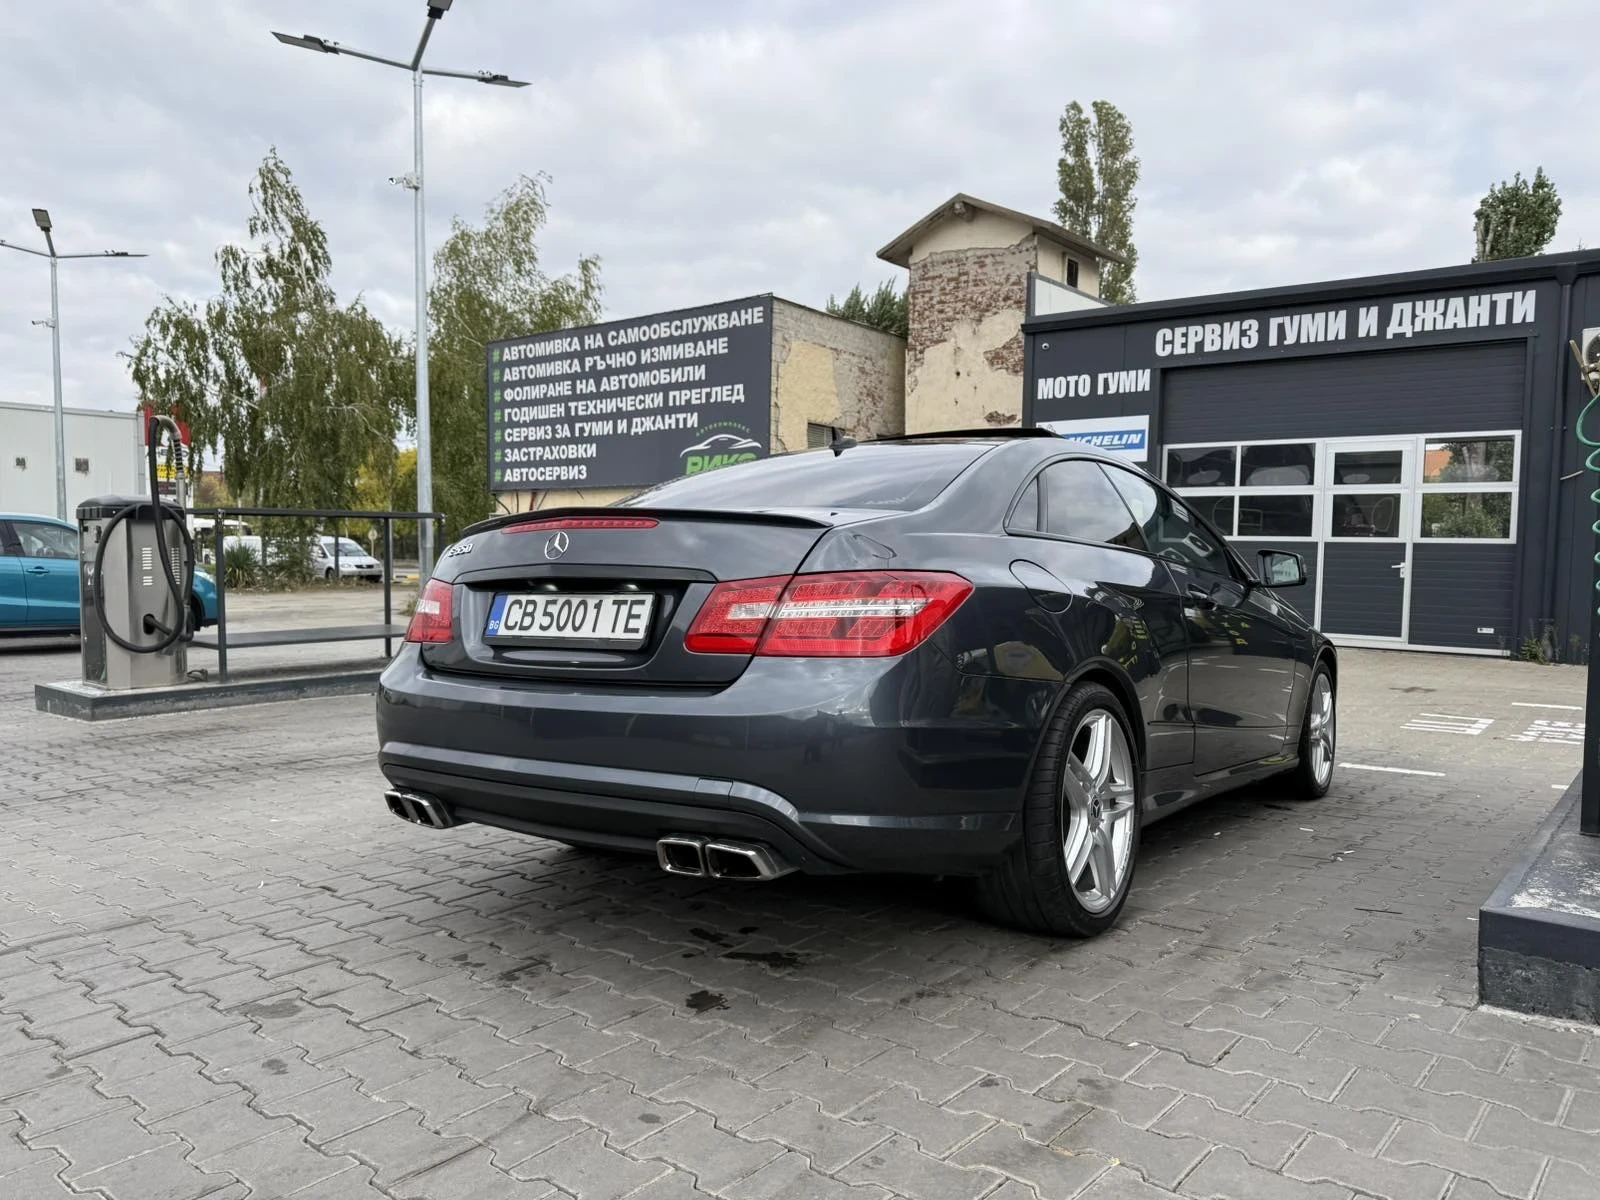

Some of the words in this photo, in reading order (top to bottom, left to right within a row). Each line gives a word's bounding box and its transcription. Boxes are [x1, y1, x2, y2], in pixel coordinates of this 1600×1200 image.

[503, 336, 581, 362] АВТОМИВКА
[584, 333, 604, 350] НА
[607, 306, 764, 346] САМООБСЛУЖВАНЕ
[1155, 318, 1259, 357] СЕРВИЗ
[1268, 309, 1347, 347] ГУМИ
[1357, 306, 1379, 338] И
[1386, 290, 1537, 340] ДЖАНТИ
[503, 358, 581, 382] АВТОМИВКА
[585, 350, 637, 372] РЪЧНО
[641, 337, 729, 365] ИЗМИВАНЕ
[503, 380, 572, 402] ФОЛИРАНЕ
[576, 378, 597, 395] НА
[600, 364, 706, 392] АВТОМОБИЛИ
[1037, 374, 1091, 400] МОТО
[1097, 368, 1151, 395] ГУМИ
[504, 402, 565, 424] ГОДИШЕН
[568, 392, 664, 416] ТЕХНИЧЕСКИ
[668, 383, 745, 407] ПРЕГЛЕД
[504, 425, 552, 442] СЕРВИЗ
[555, 423, 571, 438] ЗА
[574, 420, 613, 437] ГУМИ
[617, 418, 627, 435] И
[631, 412, 698, 436] ДЖАНТИ
[504, 443, 597, 462] ЗАСТРАХОВКИ
[504, 465, 587, 482] АВТОСЕРВИЗ
[489, 620, 500, 630] BG
[504, 599, 538, 631] CB
[539, 598, 603, 633] 5001
[610, 599, 646, 633] TE
